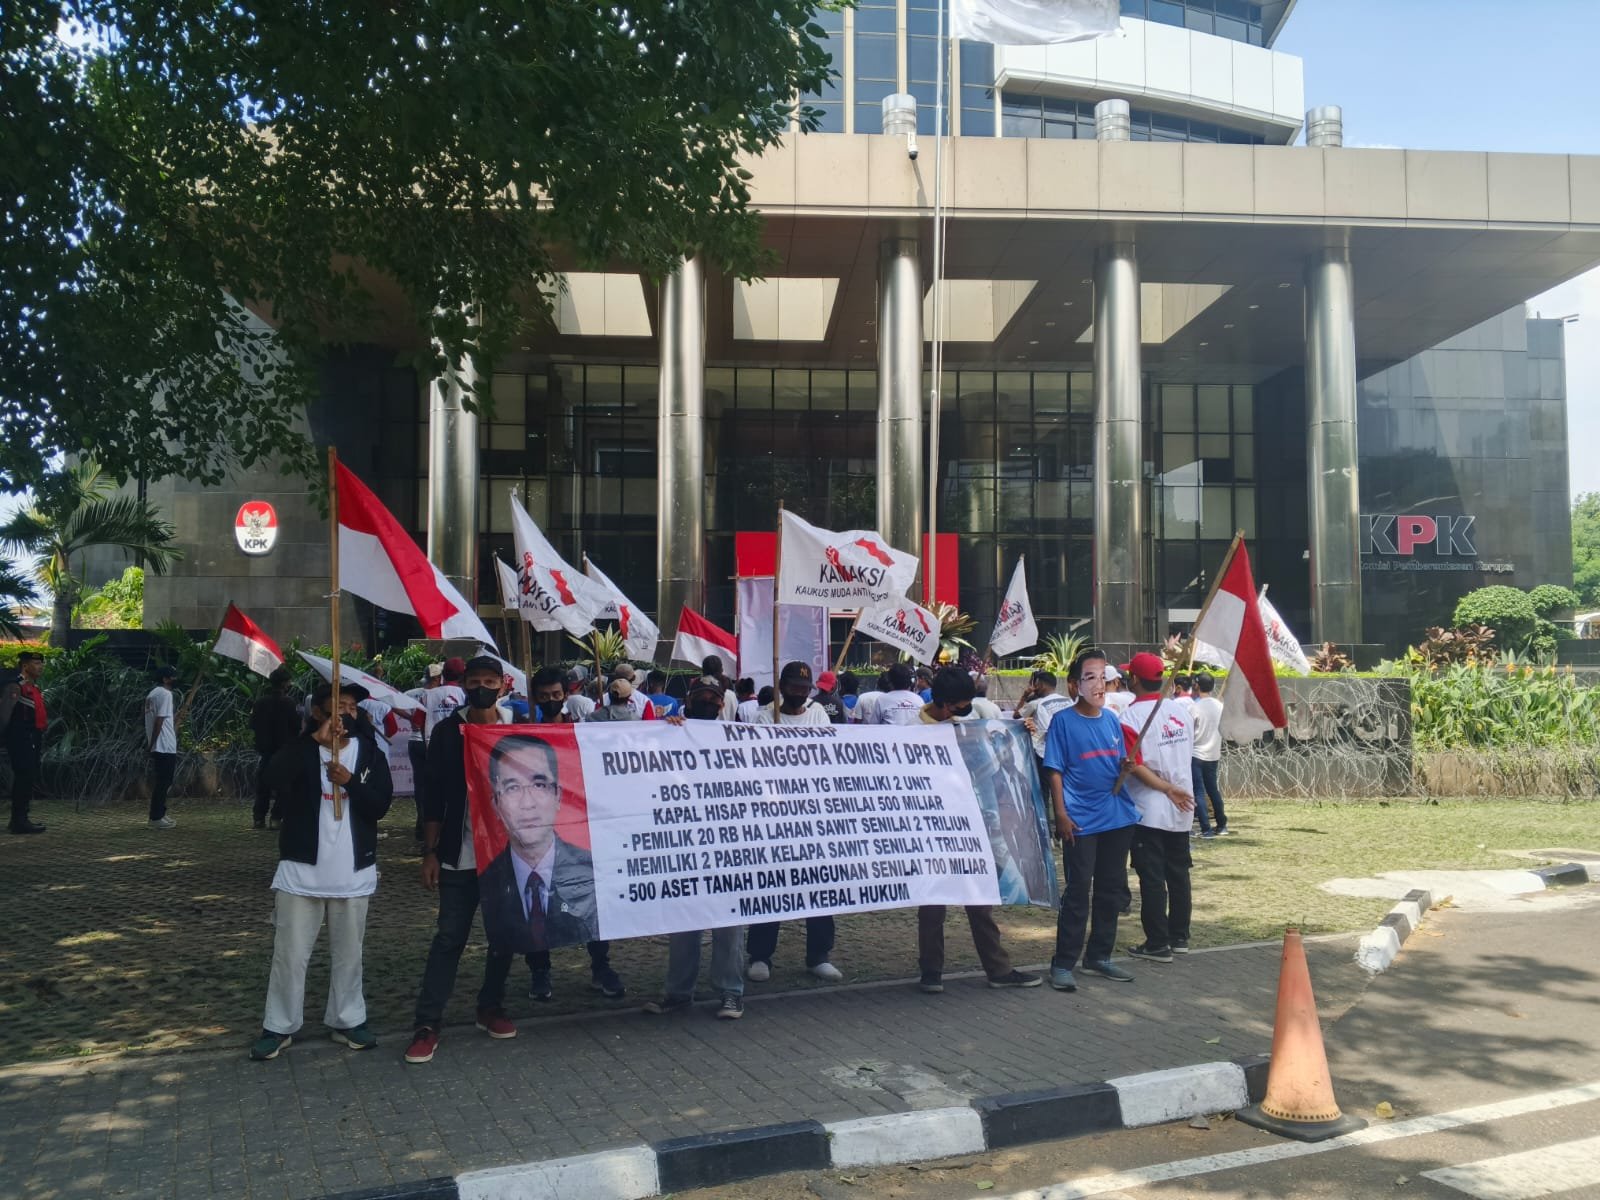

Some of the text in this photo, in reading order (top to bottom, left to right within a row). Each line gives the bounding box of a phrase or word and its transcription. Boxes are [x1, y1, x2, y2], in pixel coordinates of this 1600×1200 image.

[244, 539, 268, 549] KPK
[1360, 514, 1477, 555] KPK
[820, 563, 886, 587] KAMAKSI
[795, 585, 829, 598] KAUKUS
[831, 587, 852, 598] MUDA
[883, 615, 927, 643] KAMAKSI
[722, 724, 838, 742] KPK TANGKAP
[602, 743, 952, 776] RUDIANTO TJEN ANGGOTA KOMISI 1 DPR RI
[659, 784, 691, 801] BOS
[693, 782, 763, 800] TAMBANG
[765, 777, 809, 796] TIMAH
[812, 777, 830, 793] YG
[834, 776, 892, 793] MEMILIKI
[894, 776, 902, 791] 2
[904, 776, 932, 791] UNIT
[653, 795, 944, 825] KAPAL HISAP PRODUKSI SENILAI 500 MILIAR
[632, 829, 694, 851] PEMILIK
[697, 828, 715, 846] 20
[719, 826, 739, 843] RB
[742, 824, 762, 842] HA
[766, 820, 813, 840] LAHAN
[817, 818, 858, 837] SAWIT
[862, 816, 912, 834] SENILAI
[915, 816, 922, 831] 2
[923, 816, 971, 832] TRILIUN
[627, 852, 697, 877] MEMILIKI
[702, 852, 711, 870] 2
[715, 847, 768, 868] PABRIK
[771, 842, 826, 864] KELAPA
[828, 839, 869, 858] SAWIT
[873, 838, 924, 855] SENILAI
[926, 837, 932, 852] 1
[937, 836, 982, 853] TRILIUN
[629, 881, 656, 902] 500
[661, 877, 699, 899] ASET
[703, 873, 753, 895] TANAH
[758, 868, 786, 889] DAN
[790, 862, 869, 887] BANGUNAN
[872, 859, 923, 878] SENILAI
[925, 858, 947, 875] 700
[950, 858, 988, 875] MILIAR
[740, 892, 806, 917] MANUSIA
[809, 887, 858, 909] KEBAL
[859, 882, 910, 904] HUKUM
